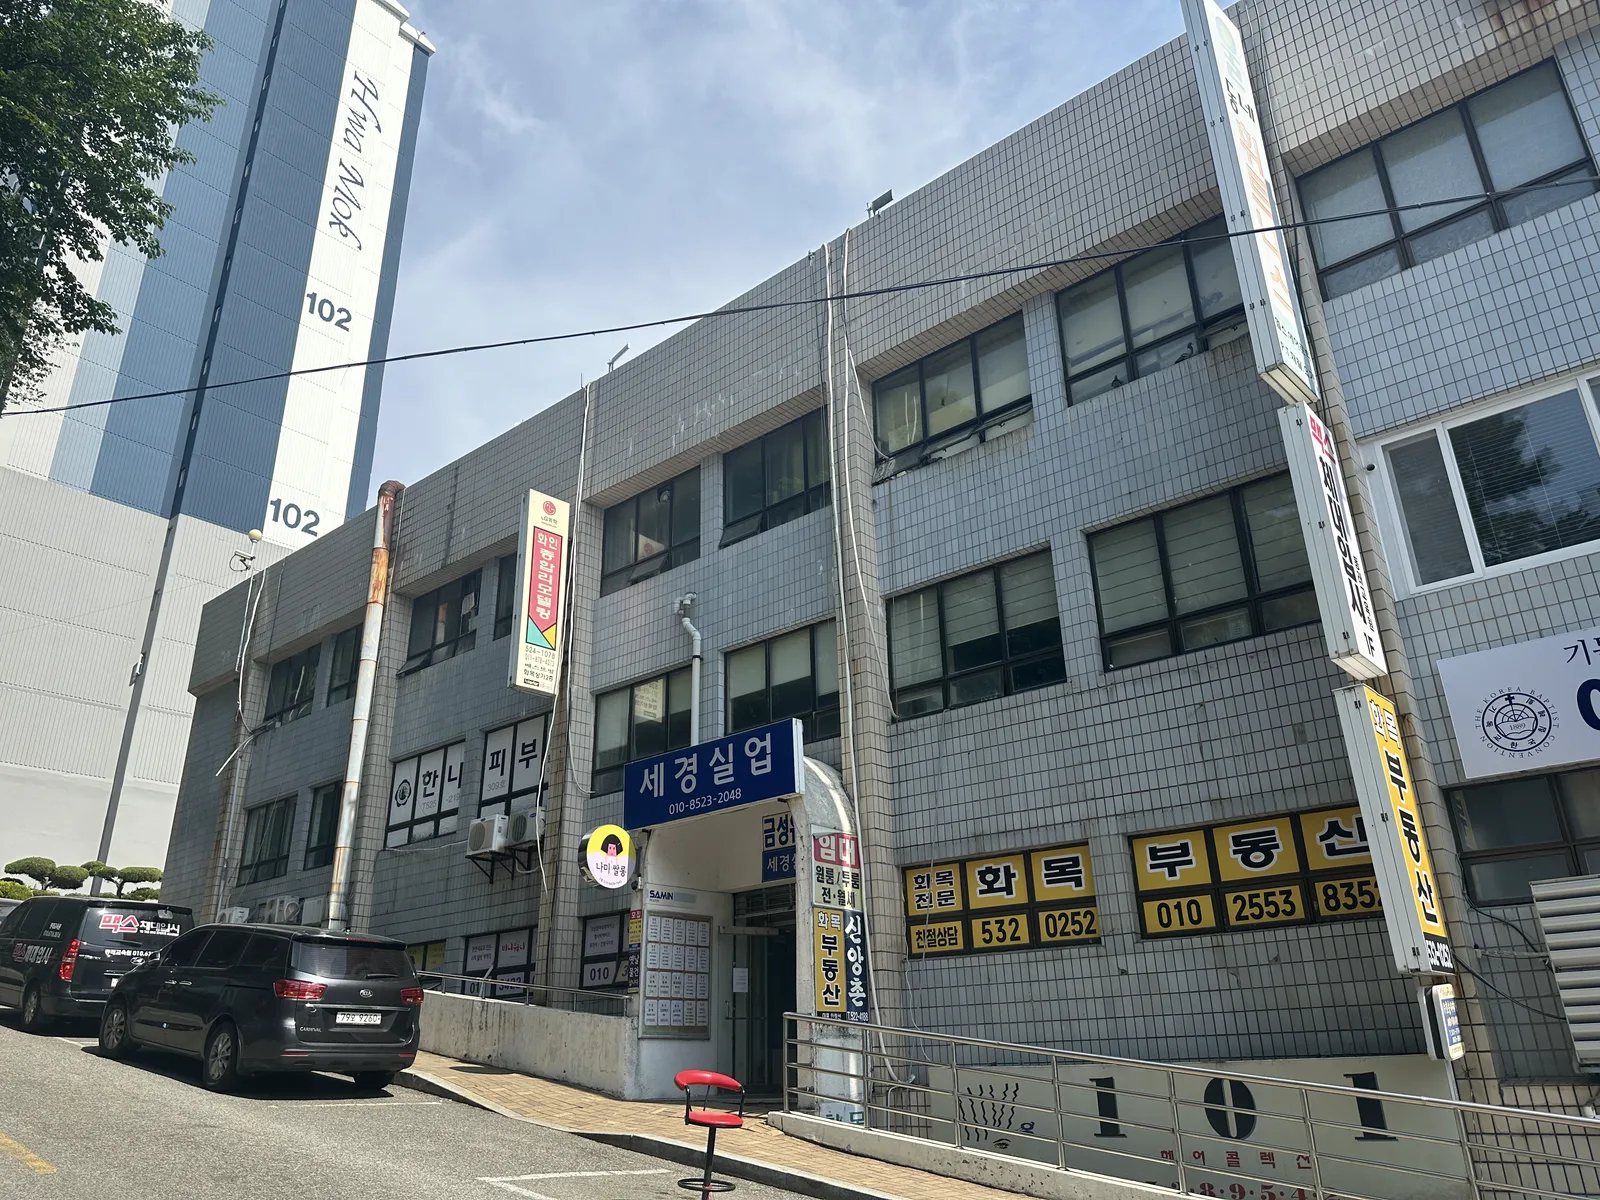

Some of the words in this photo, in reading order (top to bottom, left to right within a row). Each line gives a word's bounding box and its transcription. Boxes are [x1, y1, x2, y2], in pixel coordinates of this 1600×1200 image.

[343, 70, 381, 155] Hwa
[1225, 77, 1255, 122] 동네
[328, 158, 366, 251] Mok
[306, 292, 352, 332] 102
[1310, 414, 1336, 464] 맥스
[270, 498, 320, 536] 102
[537, 533, 558, 550] 화인
[1319, 456, 1367, 625] 체대입시
[536, 548, 556, 620] 종합리모델링
[1483, 686, 1521, 704] KOREA
[1529, 689, 1560, 729] BAPTIST
[1369, 698, 1401, 750] 화목
[1475, 708, 1483, 729] THE
[489, 739, 538, 777] 피부
[639, 732, 772, 798] 세경실업
[1480, 735, 1556, 758] CONVENTION
[669, 788, 742, 815] 010-8523-2048
[819, 835, 856, 865] 임대
[1384, 746, 1440, 927] 부동산
[767, 854, 796, 872] 세경
[976, 853, 1086, 898] 화목
[914, 889, 956, 911] 전문
[1156, 898, 1202, 928] 010
[1232, 889, 1296, 922] 2553
[99, 915, 140, 934] 맥스
[818, 911, 841, 931] 화목
[915, 925, 958, 949] 친절상담
[981, 917, 1021, 945] 532
[1045, 910, 1097, 938] 0252
[590, 967, 609, 981] 010
[821, 934, 841, 1007] 부동산
[845, 915, 867, 1007] 신앙촌
[359, 1012, 379, 1023] 9260
